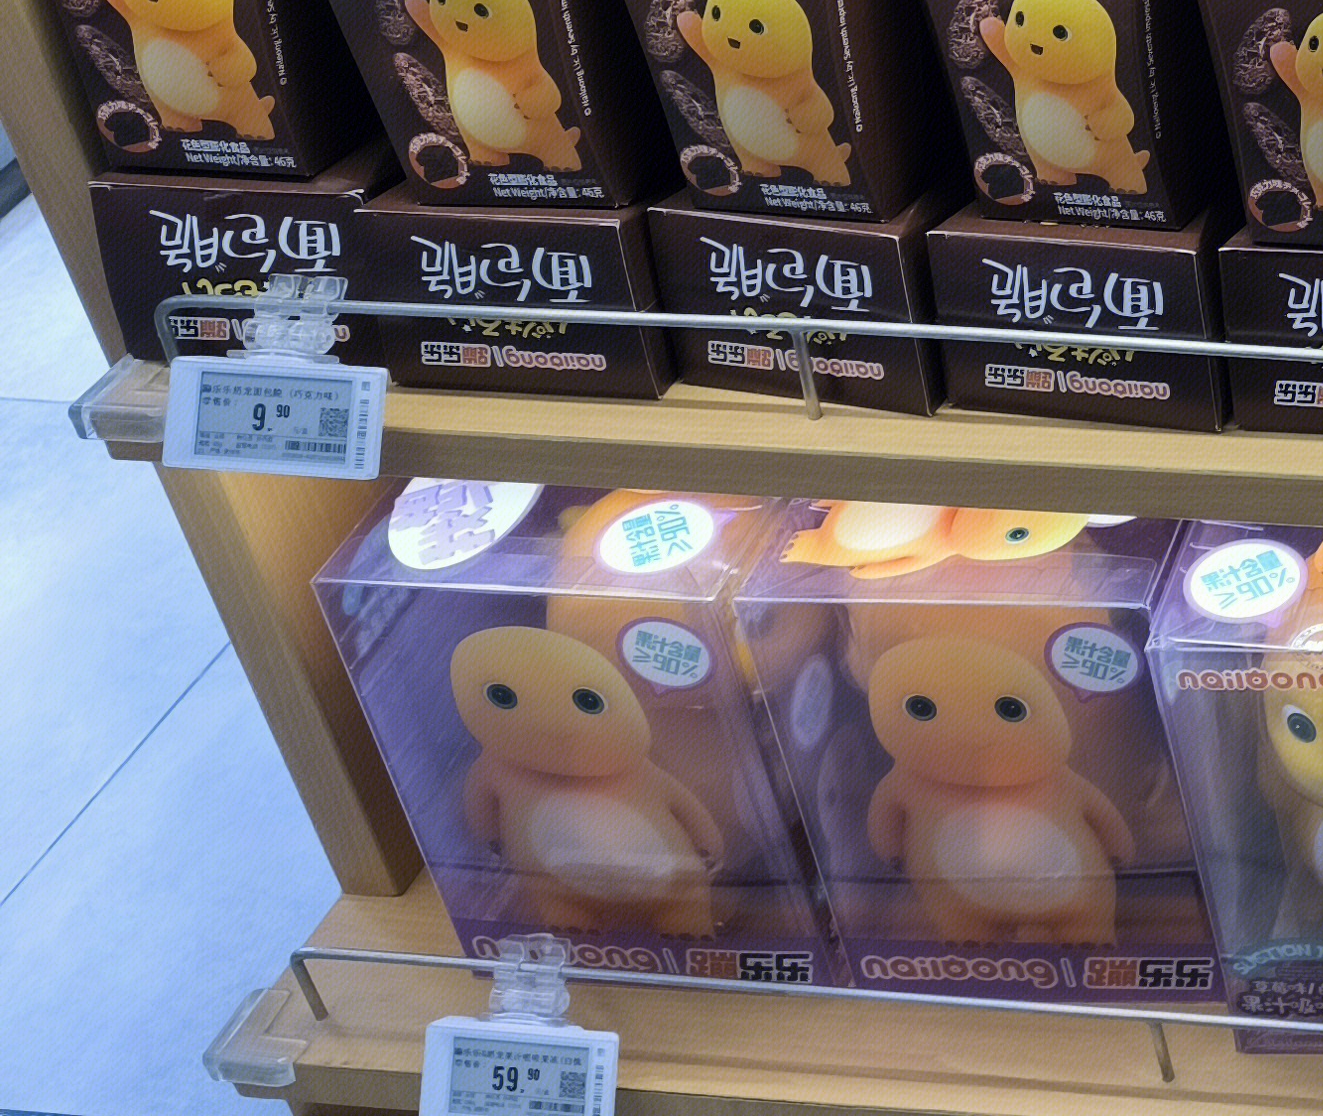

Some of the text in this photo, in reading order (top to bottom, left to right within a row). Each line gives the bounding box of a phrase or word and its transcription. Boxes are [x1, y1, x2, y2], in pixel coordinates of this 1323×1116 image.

[149, 210, 343, 274] 面包脆
[411, 236, 593, 303] 面包脆
[863, 955, 1057, 988] nailoong
[1233, 944, 1311, 976] SUCTION
